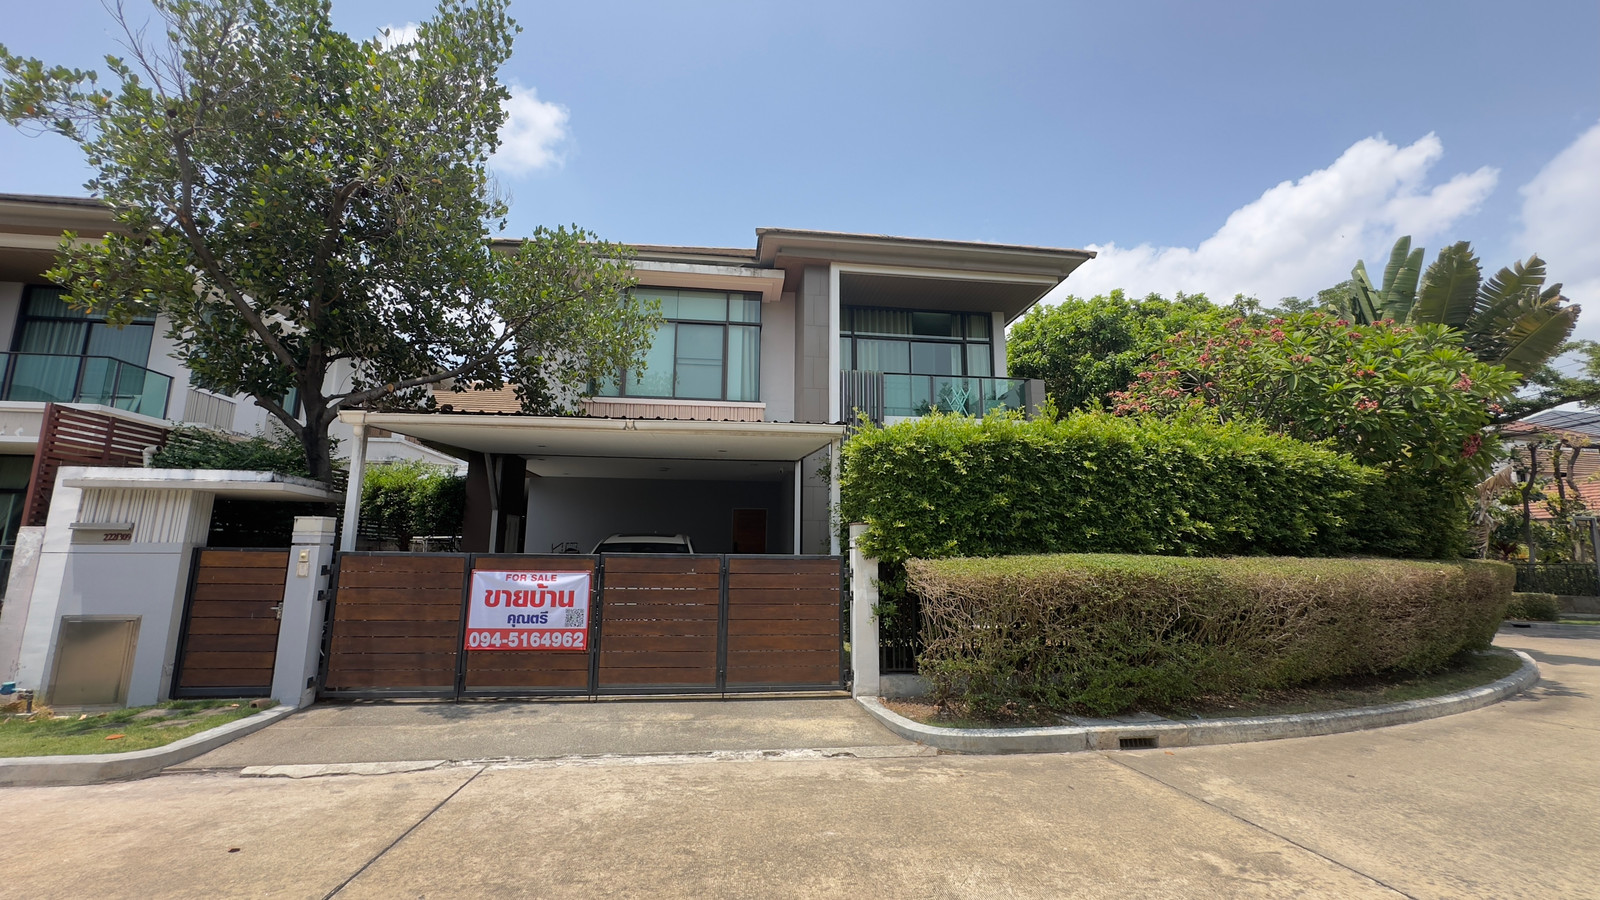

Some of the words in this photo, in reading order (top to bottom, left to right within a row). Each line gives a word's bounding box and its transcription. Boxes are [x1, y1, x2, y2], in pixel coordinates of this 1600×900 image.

[505, 573, 527, 582] FOR
[530, 573, 558, 582] SALE
[484, 583, 575, 608] ขายบ้าน
[507, 611, 549, 627] คุณตรี
[469, 631, 584, 648] 094-5164962
